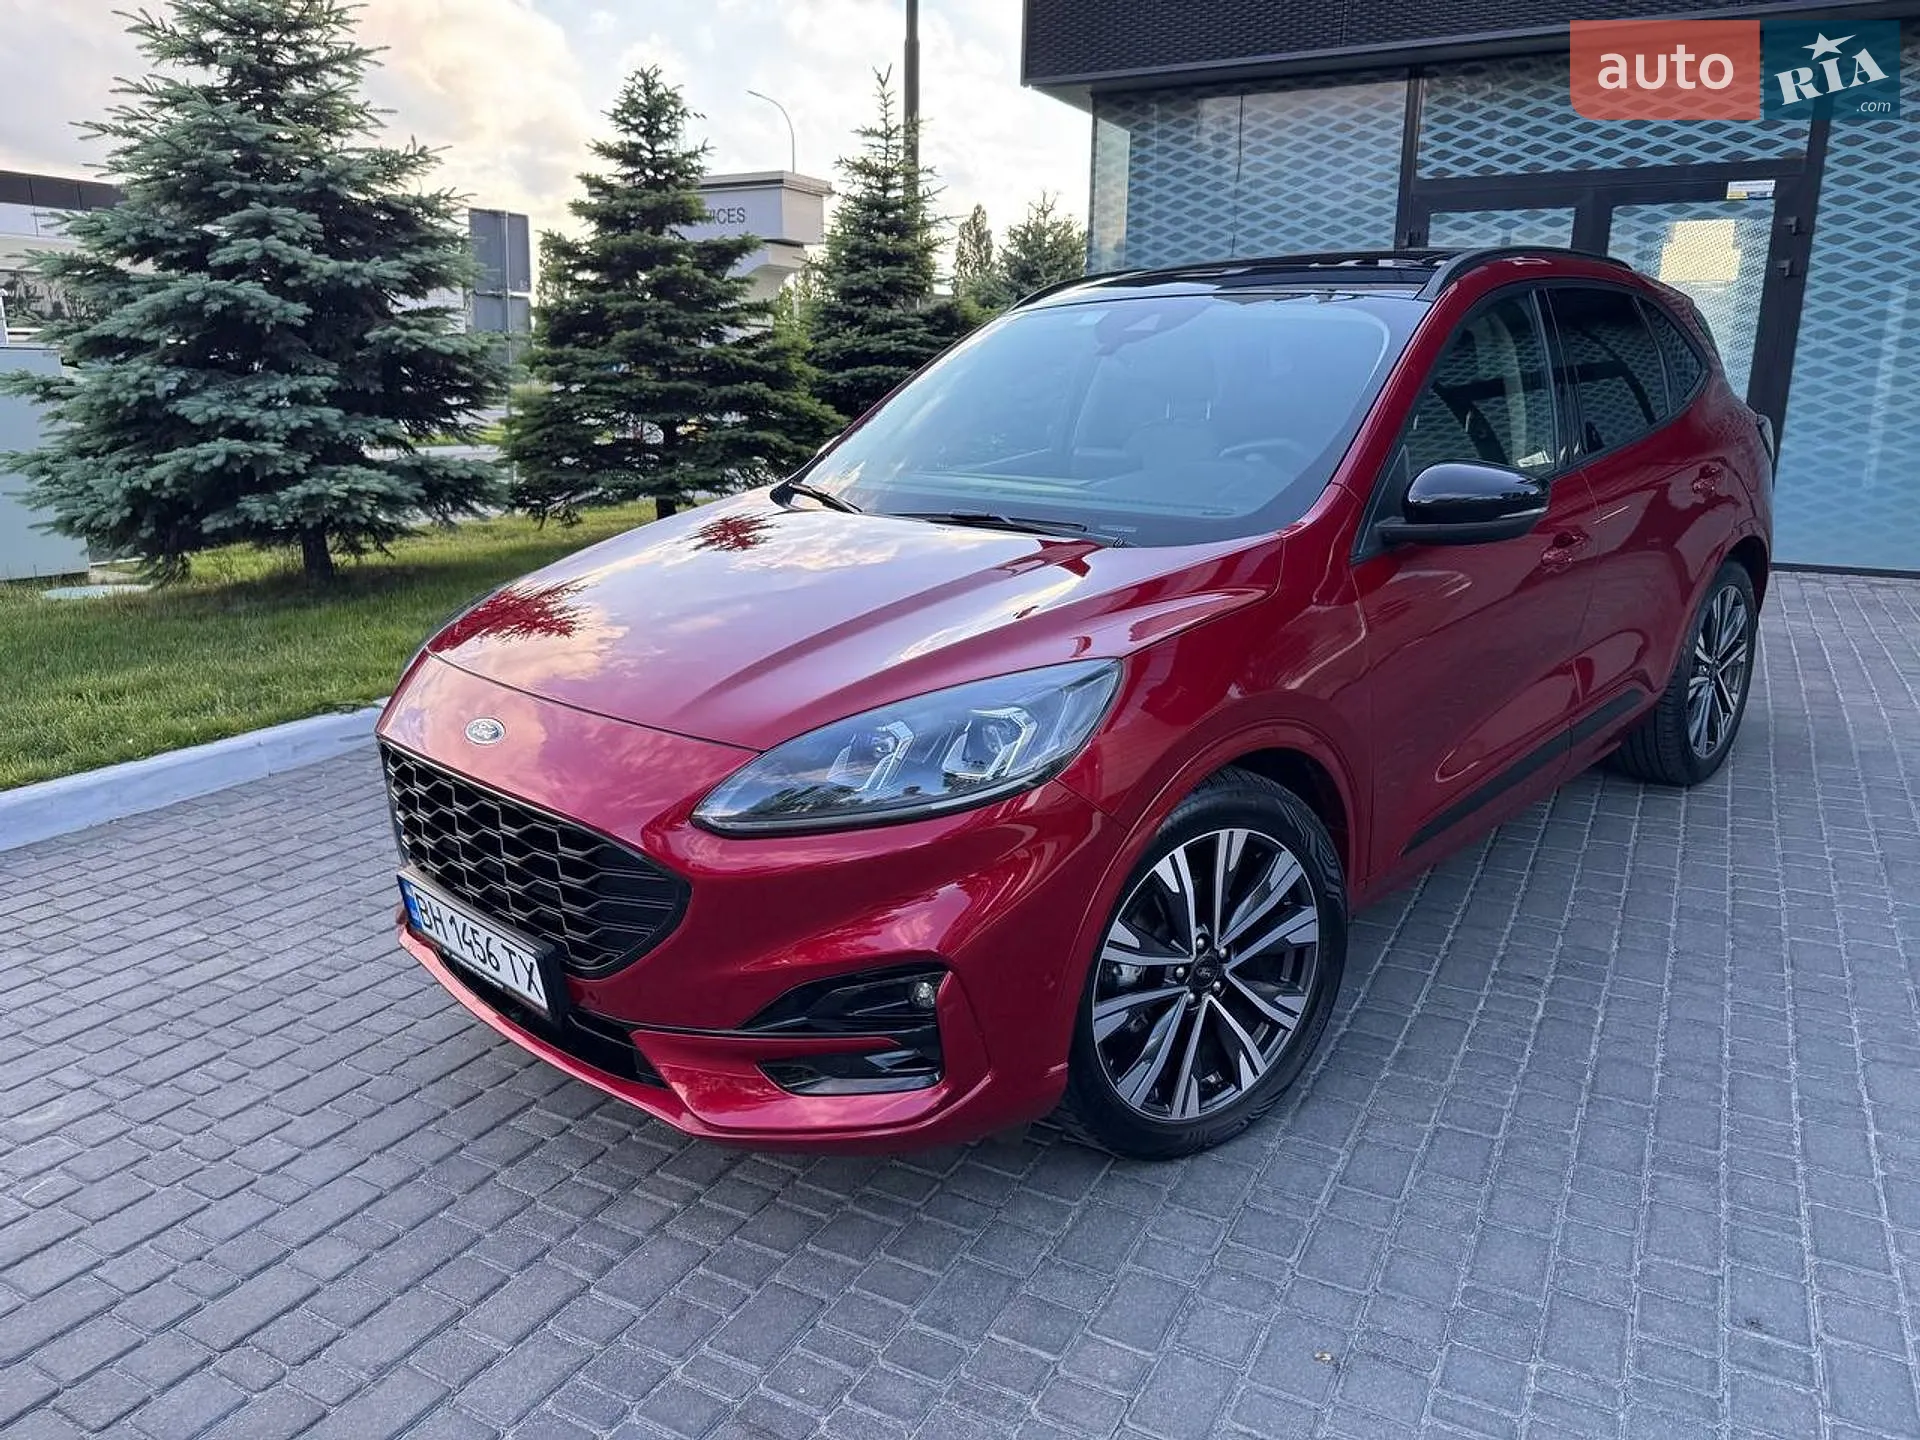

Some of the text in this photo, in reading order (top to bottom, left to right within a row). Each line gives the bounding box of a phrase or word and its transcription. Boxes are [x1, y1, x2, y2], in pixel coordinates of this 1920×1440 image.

[414, 893, 543, 1000] BH 1456 TX
